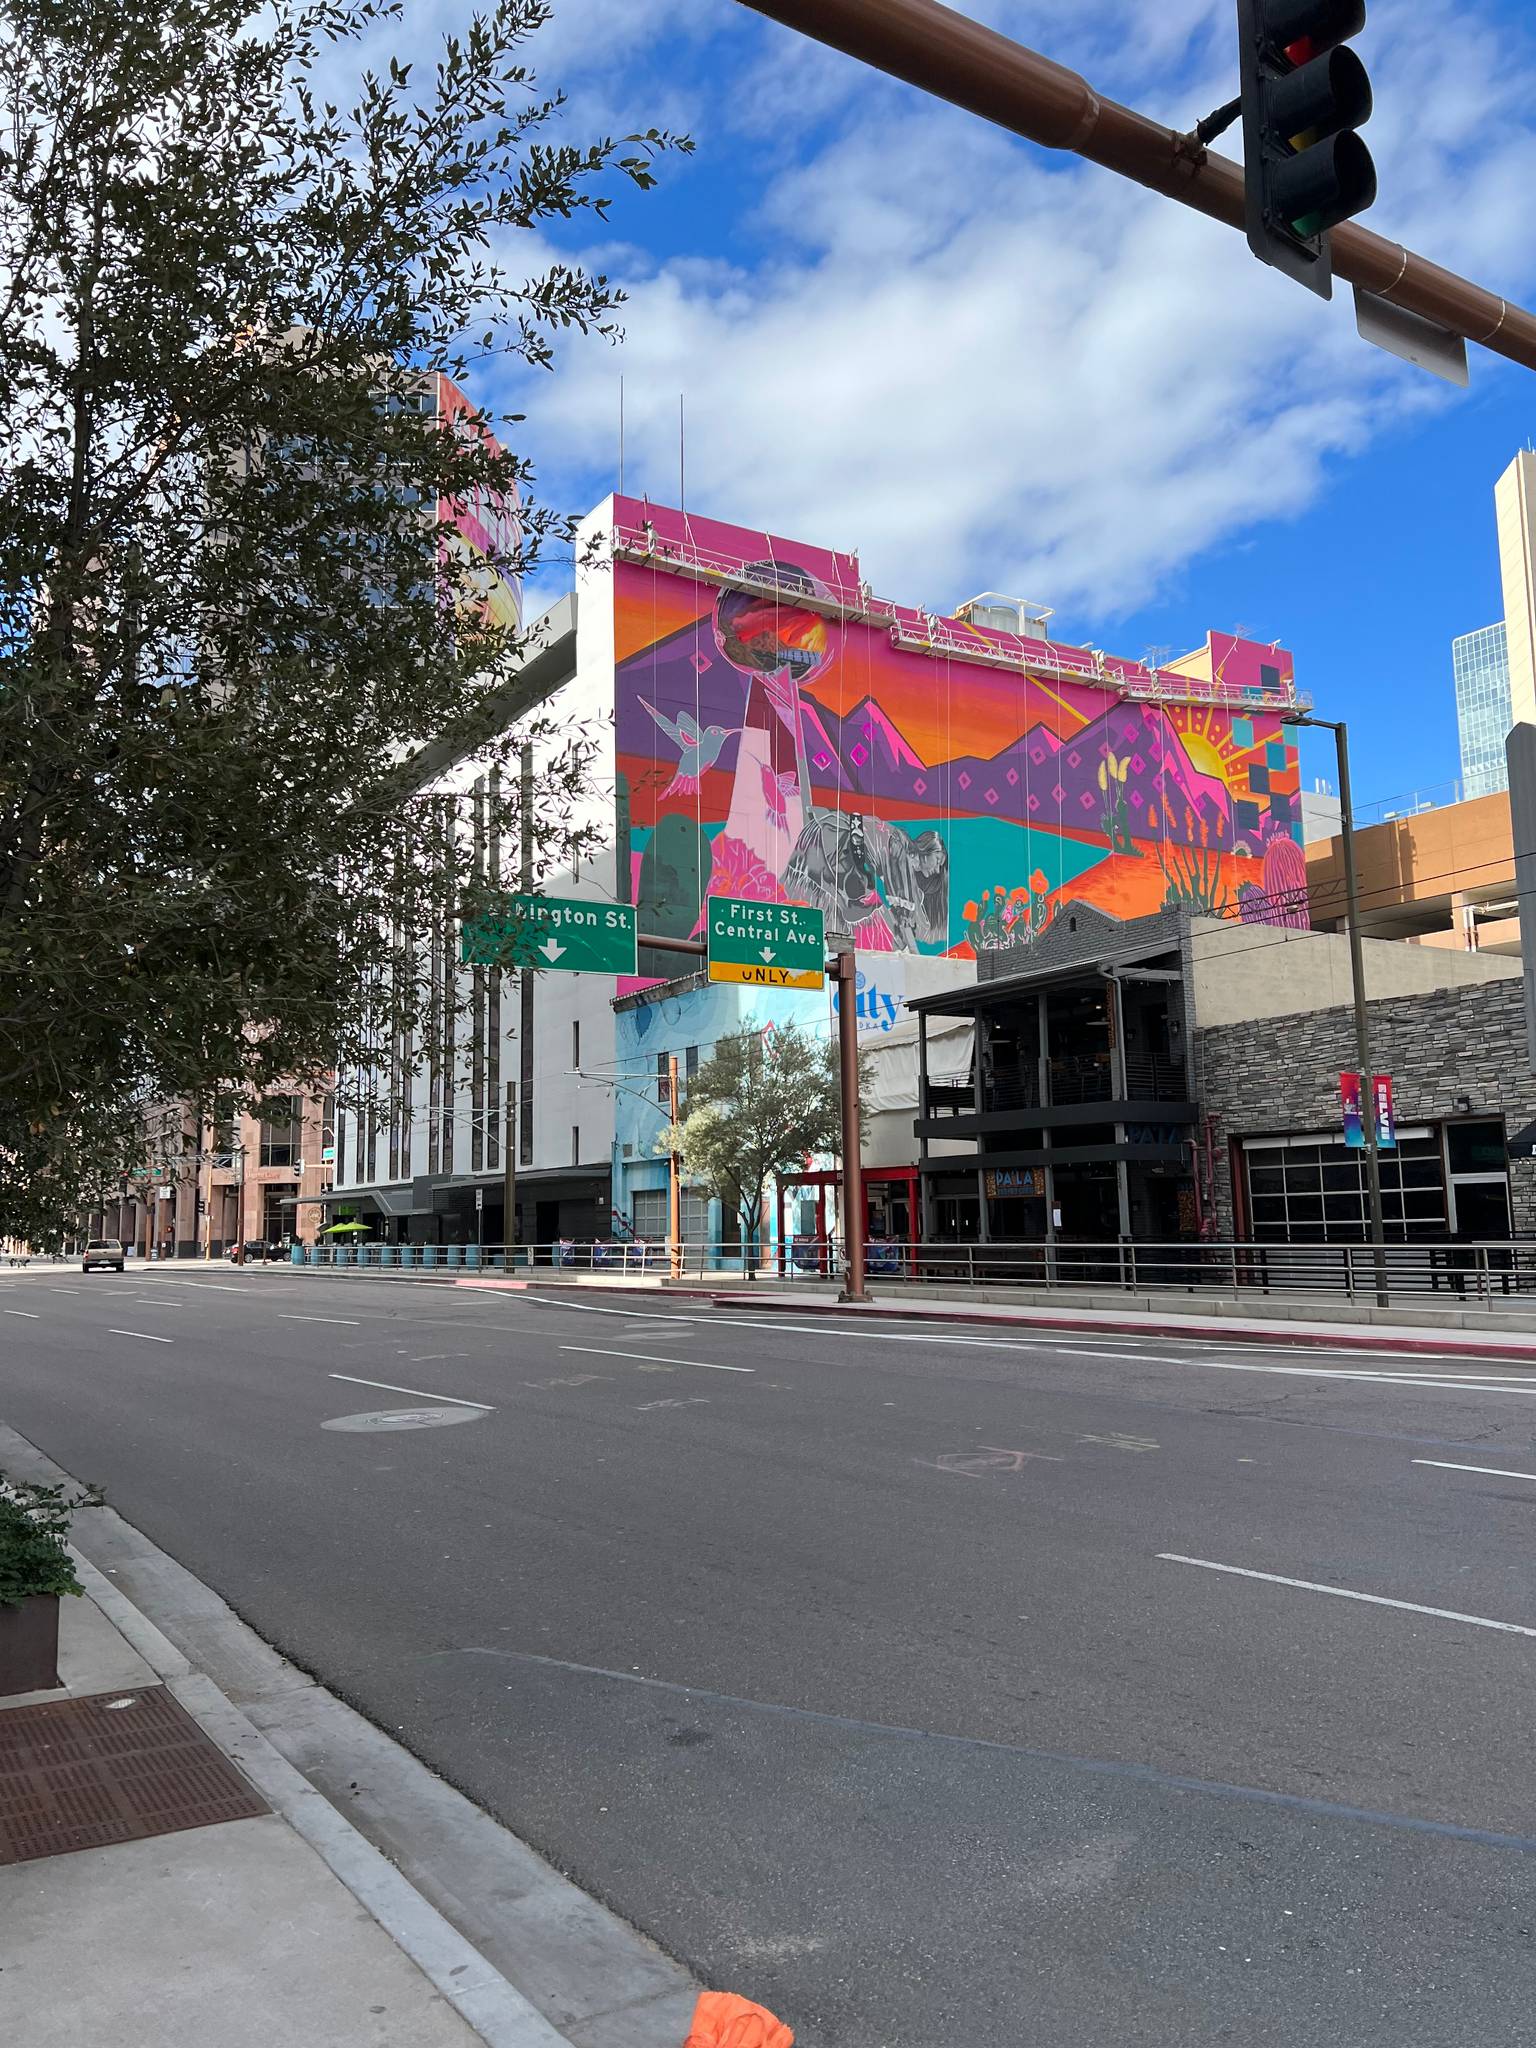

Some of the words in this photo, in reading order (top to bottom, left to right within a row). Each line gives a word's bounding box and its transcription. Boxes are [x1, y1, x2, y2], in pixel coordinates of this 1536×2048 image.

[487, 902, 597, 928] hington
[605, 910, 632, 929] St.
[730, 904, 773, 922] First
[780, 910, 803, 926] St.
[715, 921, 779, 942] Central
[786, 929, 820, 946] Ave.
[833, 984, 904, 1032] ity
